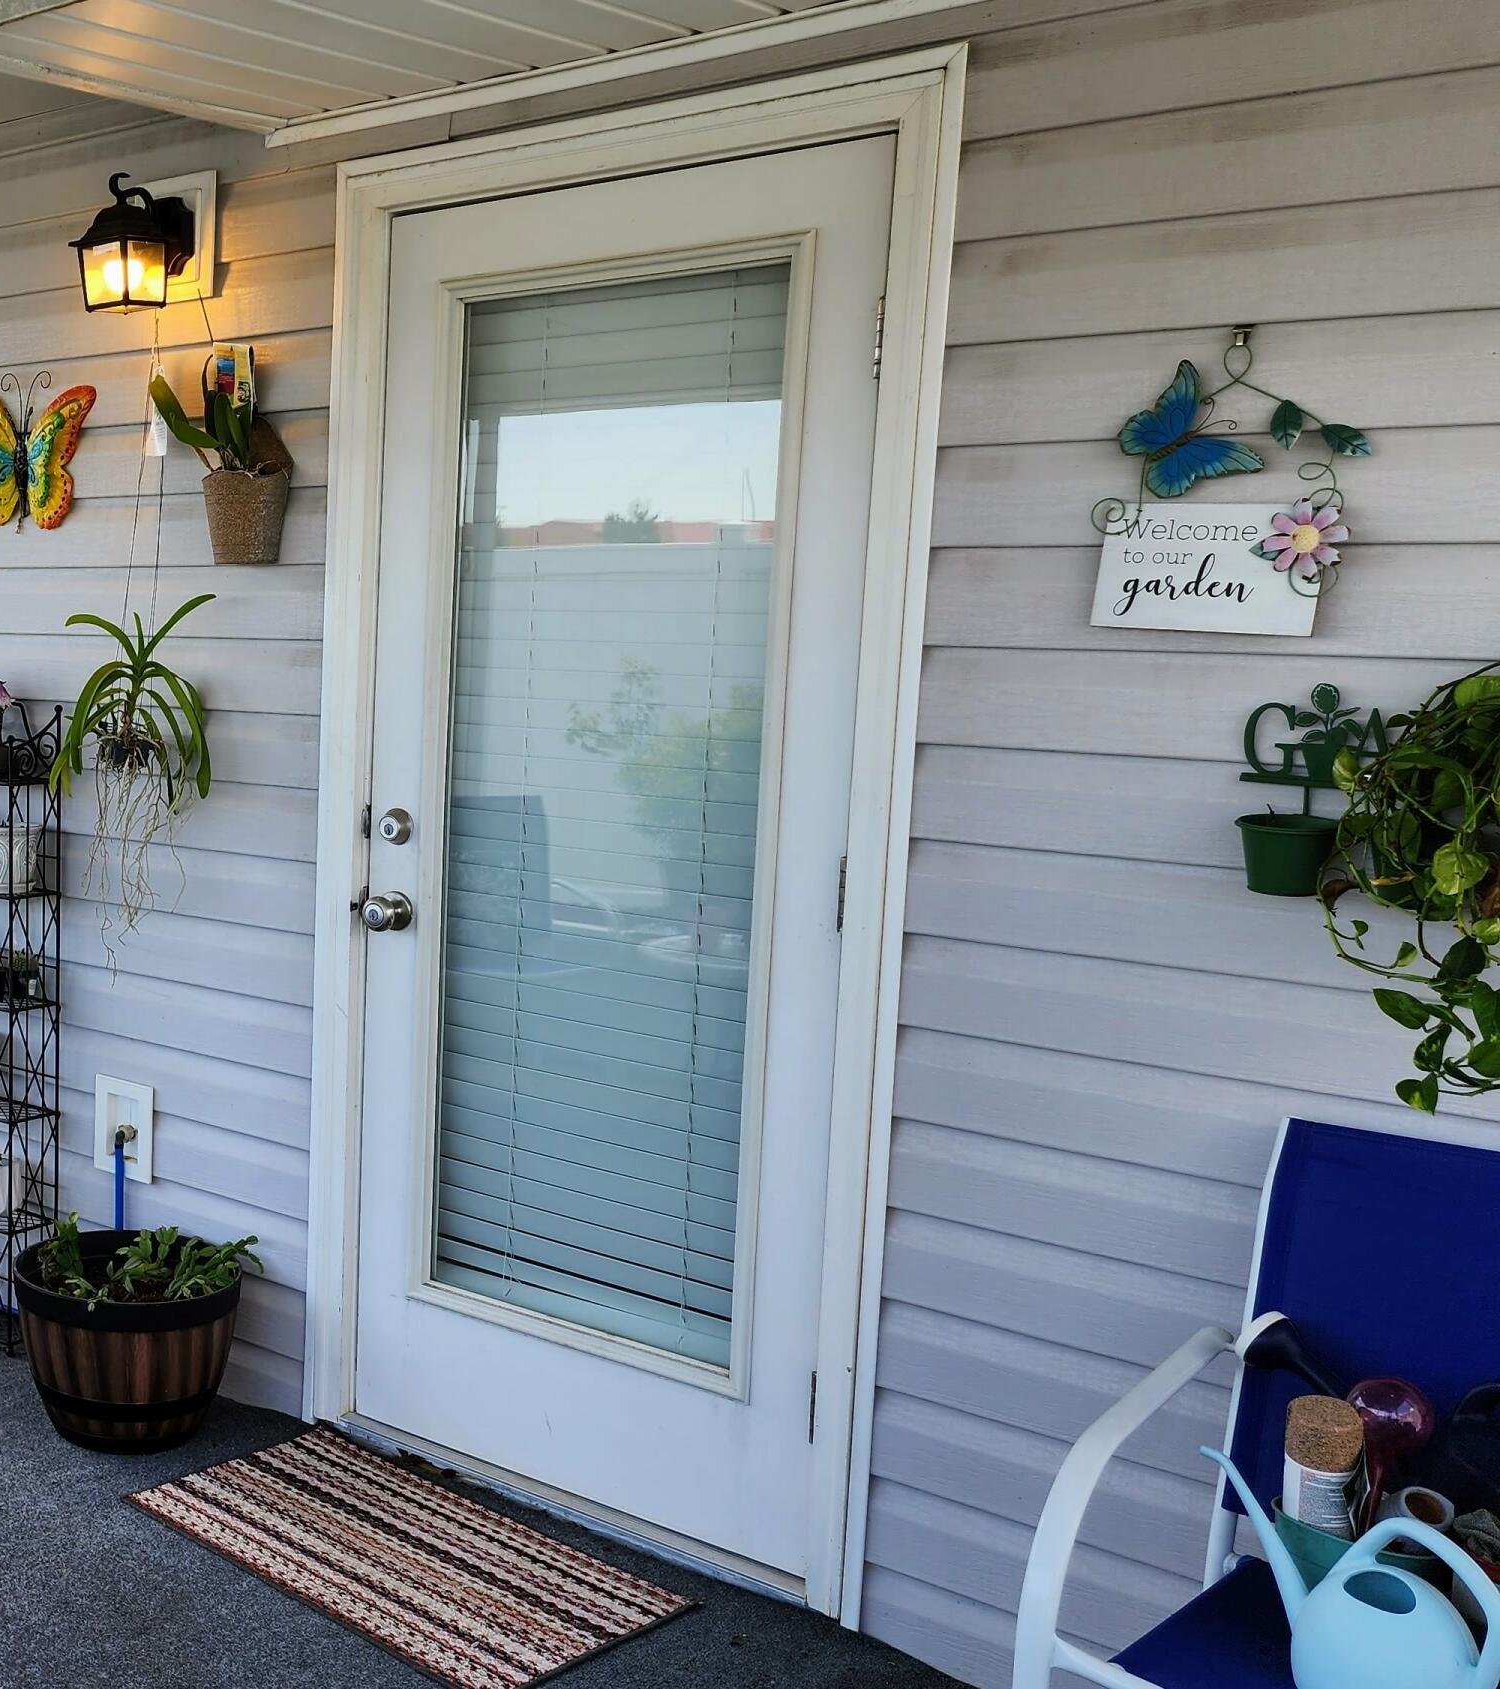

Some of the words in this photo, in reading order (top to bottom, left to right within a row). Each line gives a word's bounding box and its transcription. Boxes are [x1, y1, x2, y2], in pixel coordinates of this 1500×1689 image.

[1122, 518, 1259, 542] Welcome
[1123, 547, 1145, 564] to
[1152, 550, 1193, 565] our
[1112, 552, 1255, 617] garden
